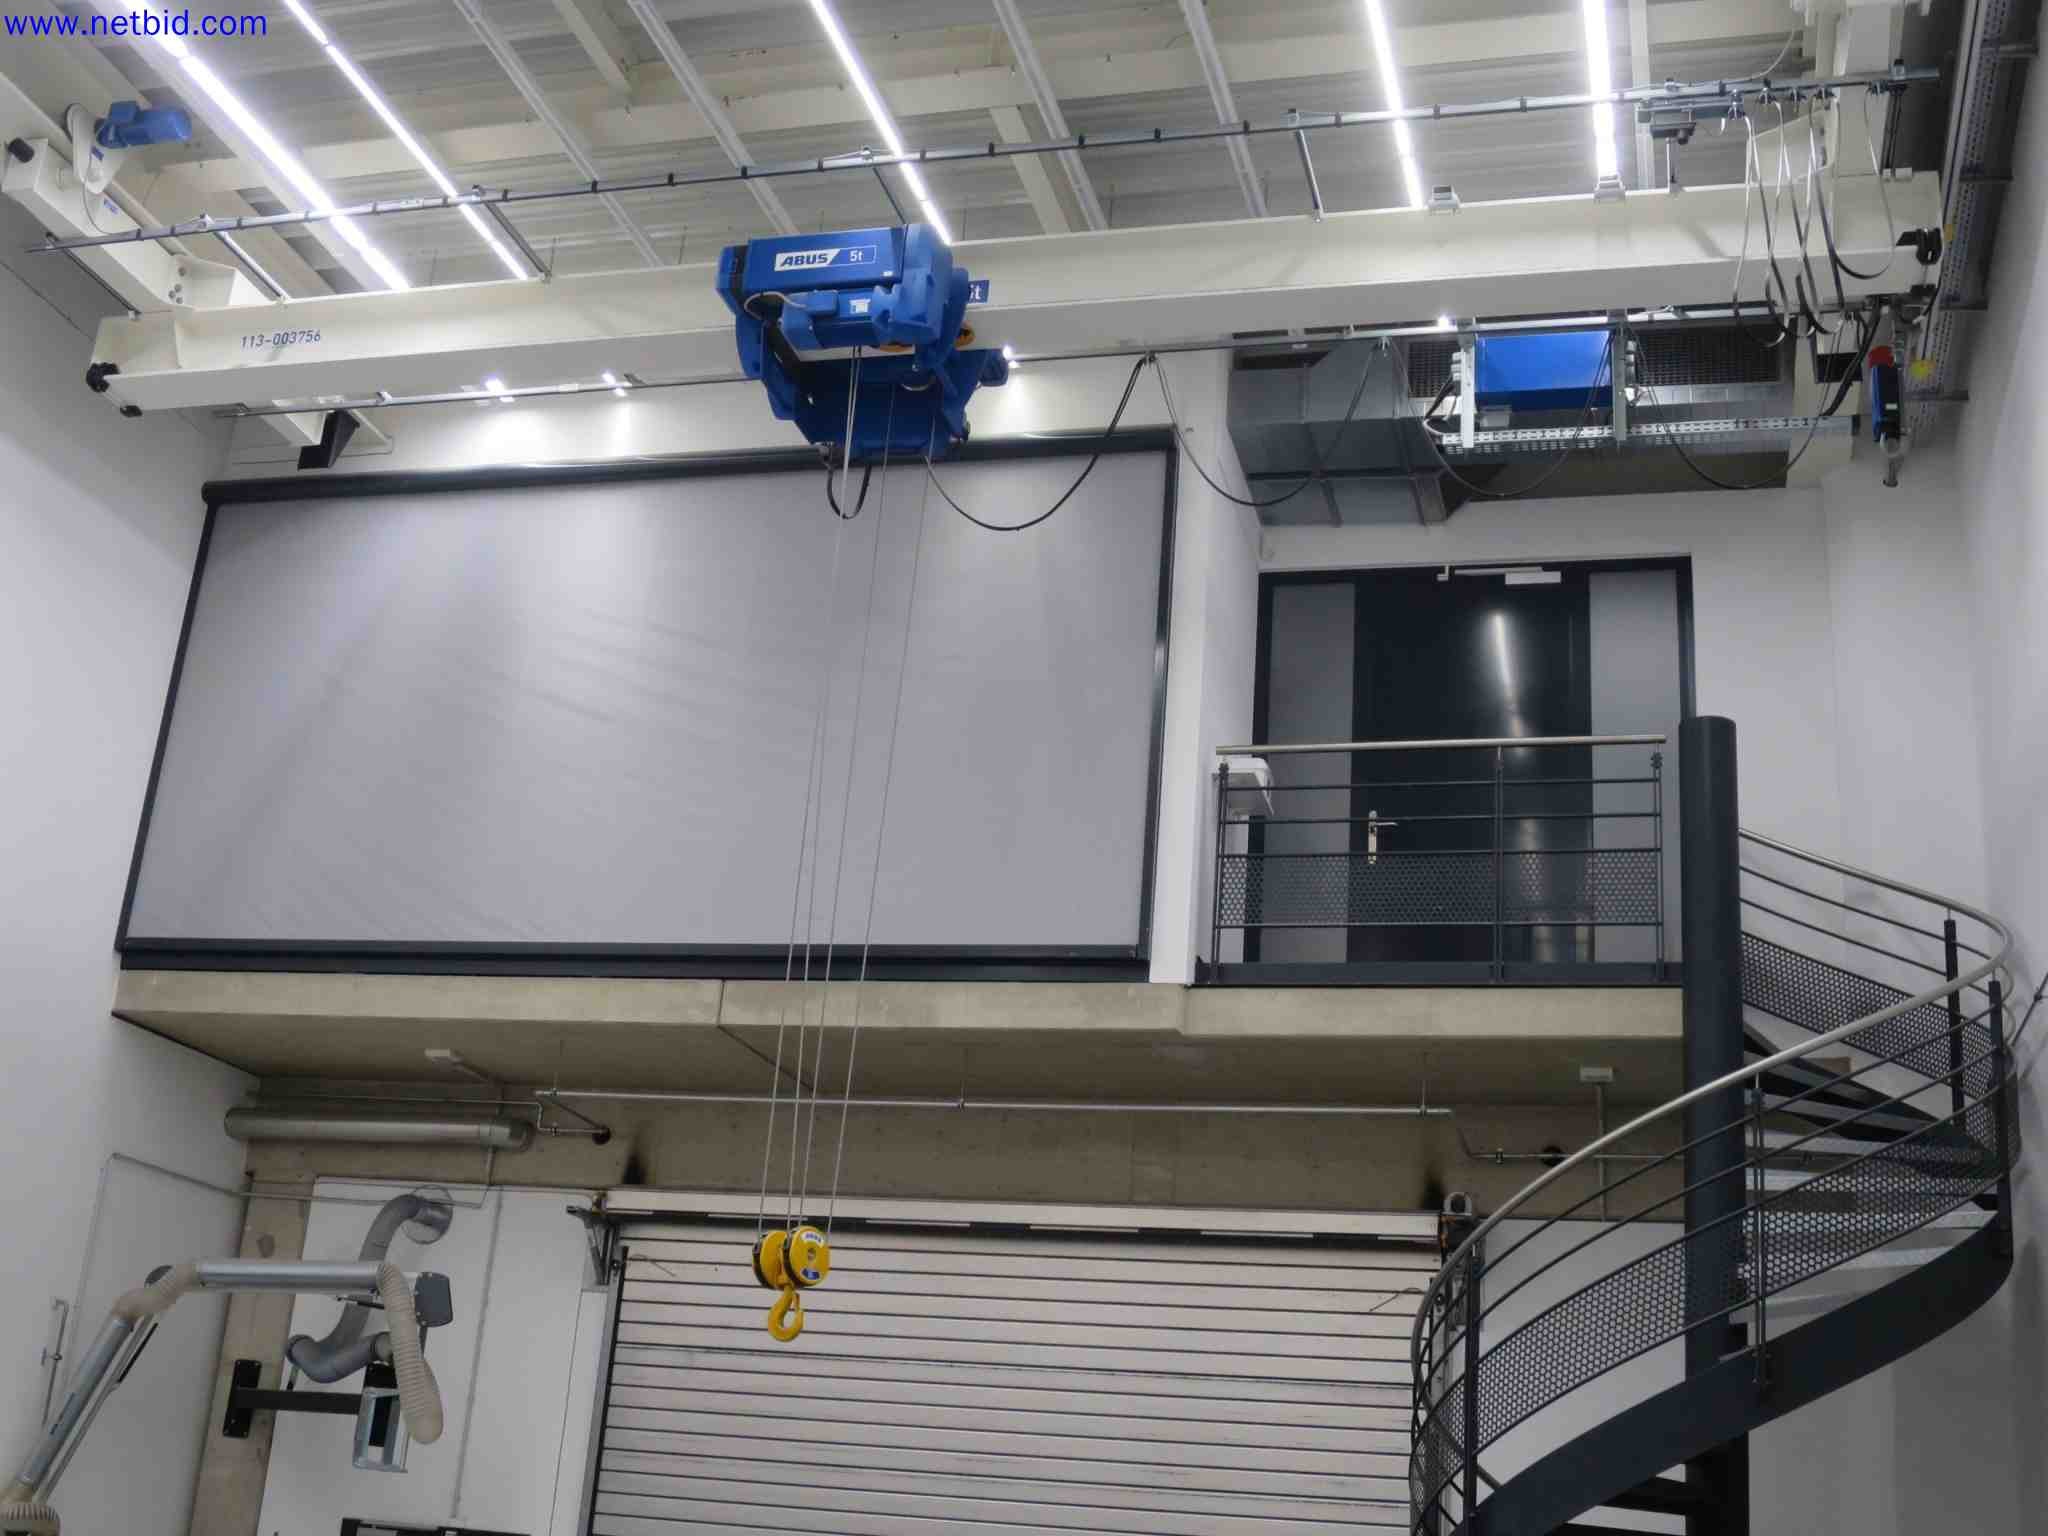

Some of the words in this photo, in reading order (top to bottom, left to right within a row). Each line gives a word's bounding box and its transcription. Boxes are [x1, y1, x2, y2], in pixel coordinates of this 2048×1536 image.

[780, 253, 829, 267] ABUS
[850, 249, 864, 262] 5t
[241, 329, 321, 349] 113-003756
